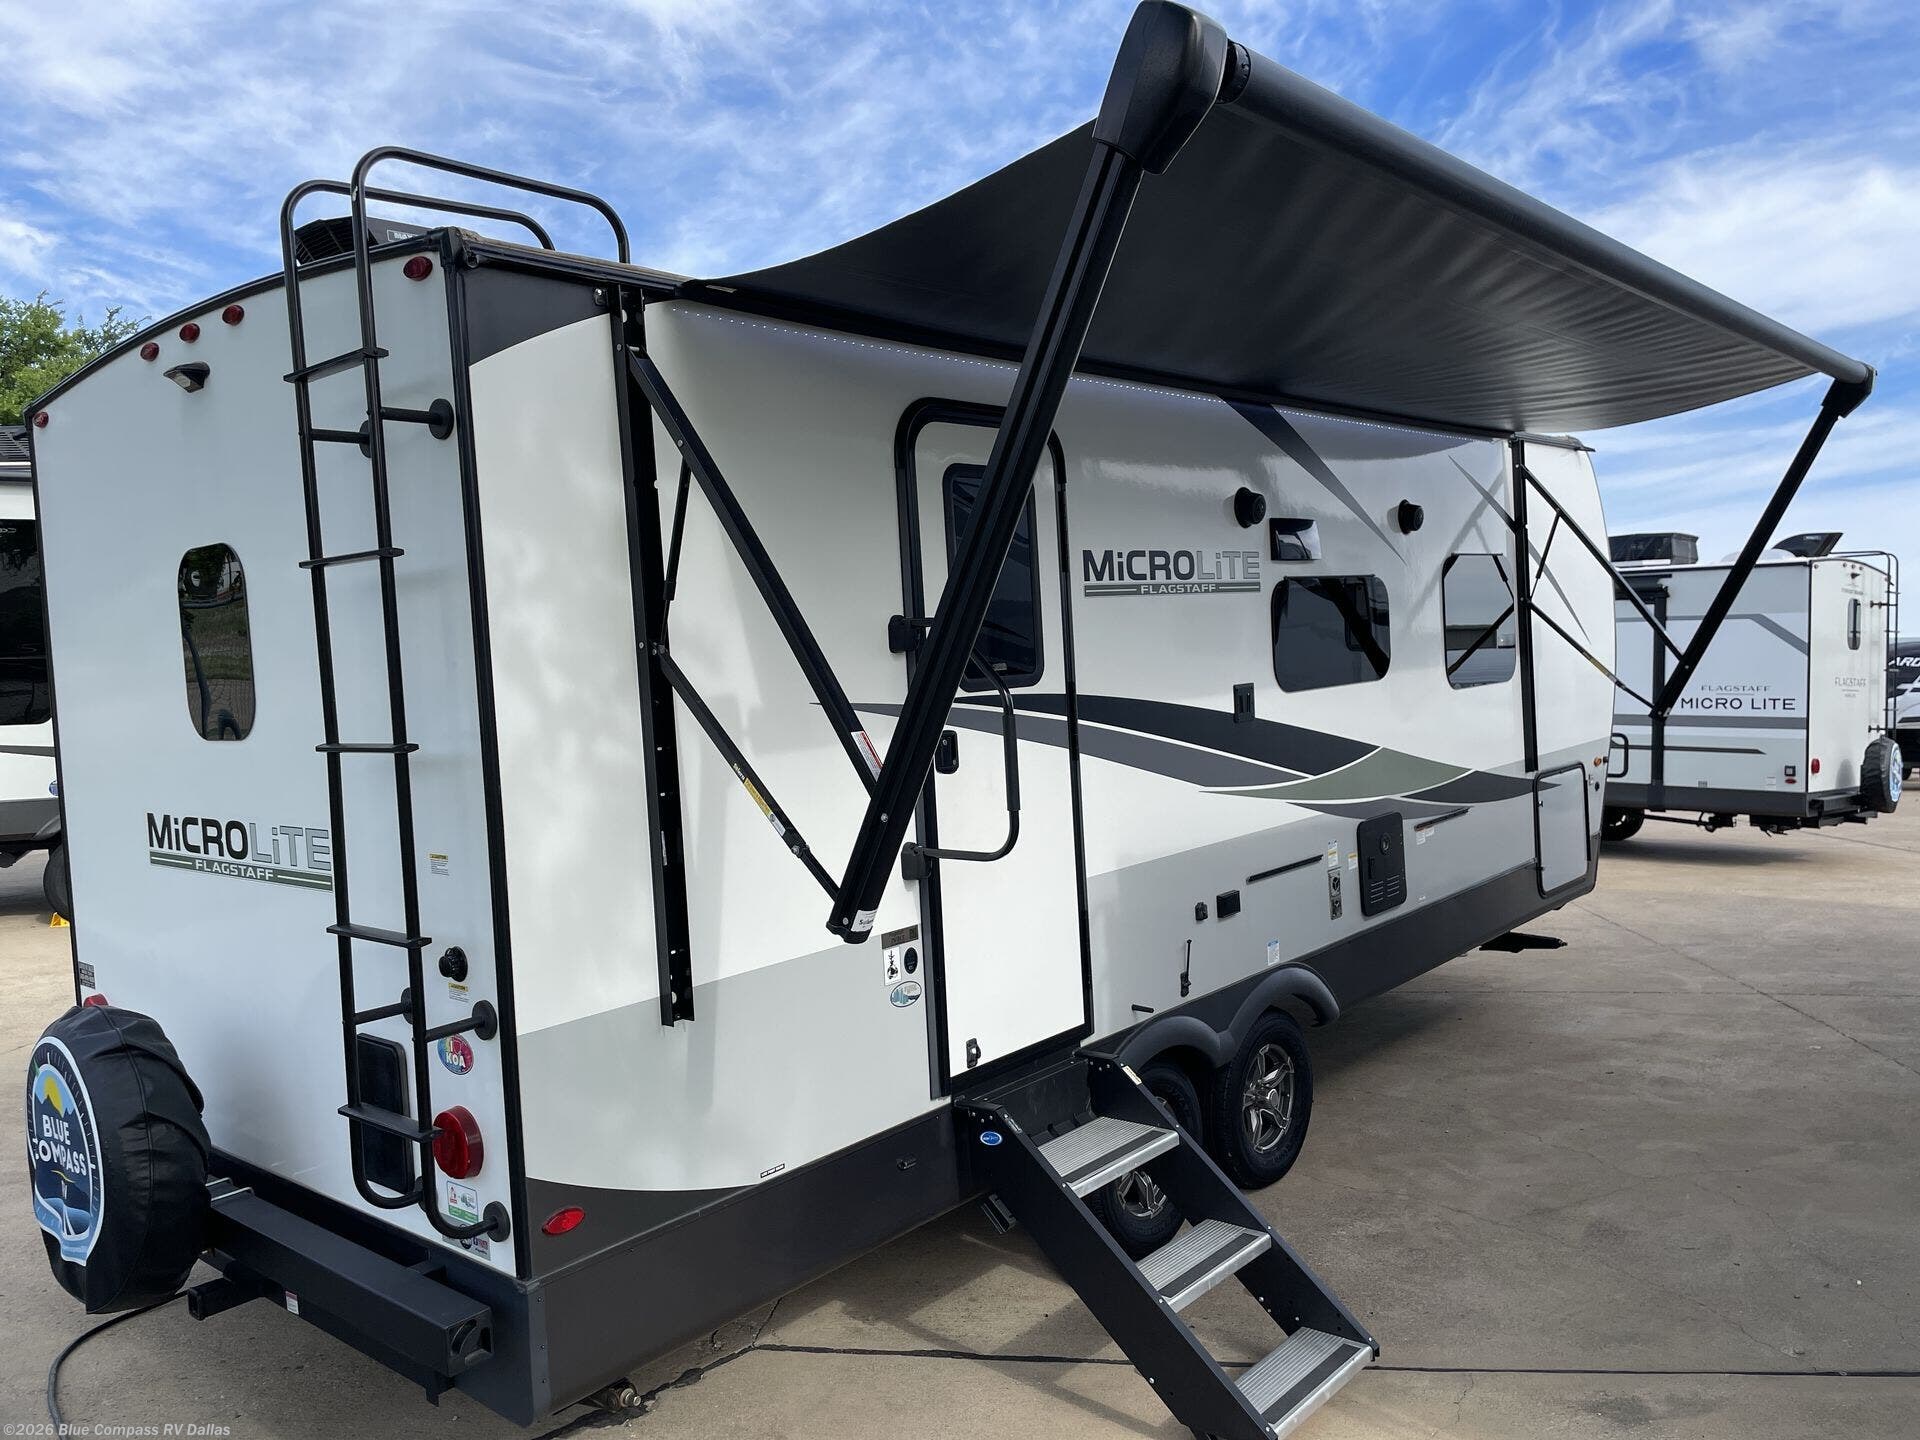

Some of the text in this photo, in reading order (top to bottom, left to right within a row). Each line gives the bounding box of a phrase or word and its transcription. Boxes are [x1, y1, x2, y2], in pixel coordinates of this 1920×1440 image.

[1140, 583, 1217, 595] FLAGSTAFF
[1701, 684, 1772, 693] FLAGSTAFF
[1681, 697, 1796, 711] MICRO LITE
[195, 858, 274, 881] FLAGSTAFF
[446, 1052, 466, 1068] KOA
[42, 1114, 71, 1146] BLUE
